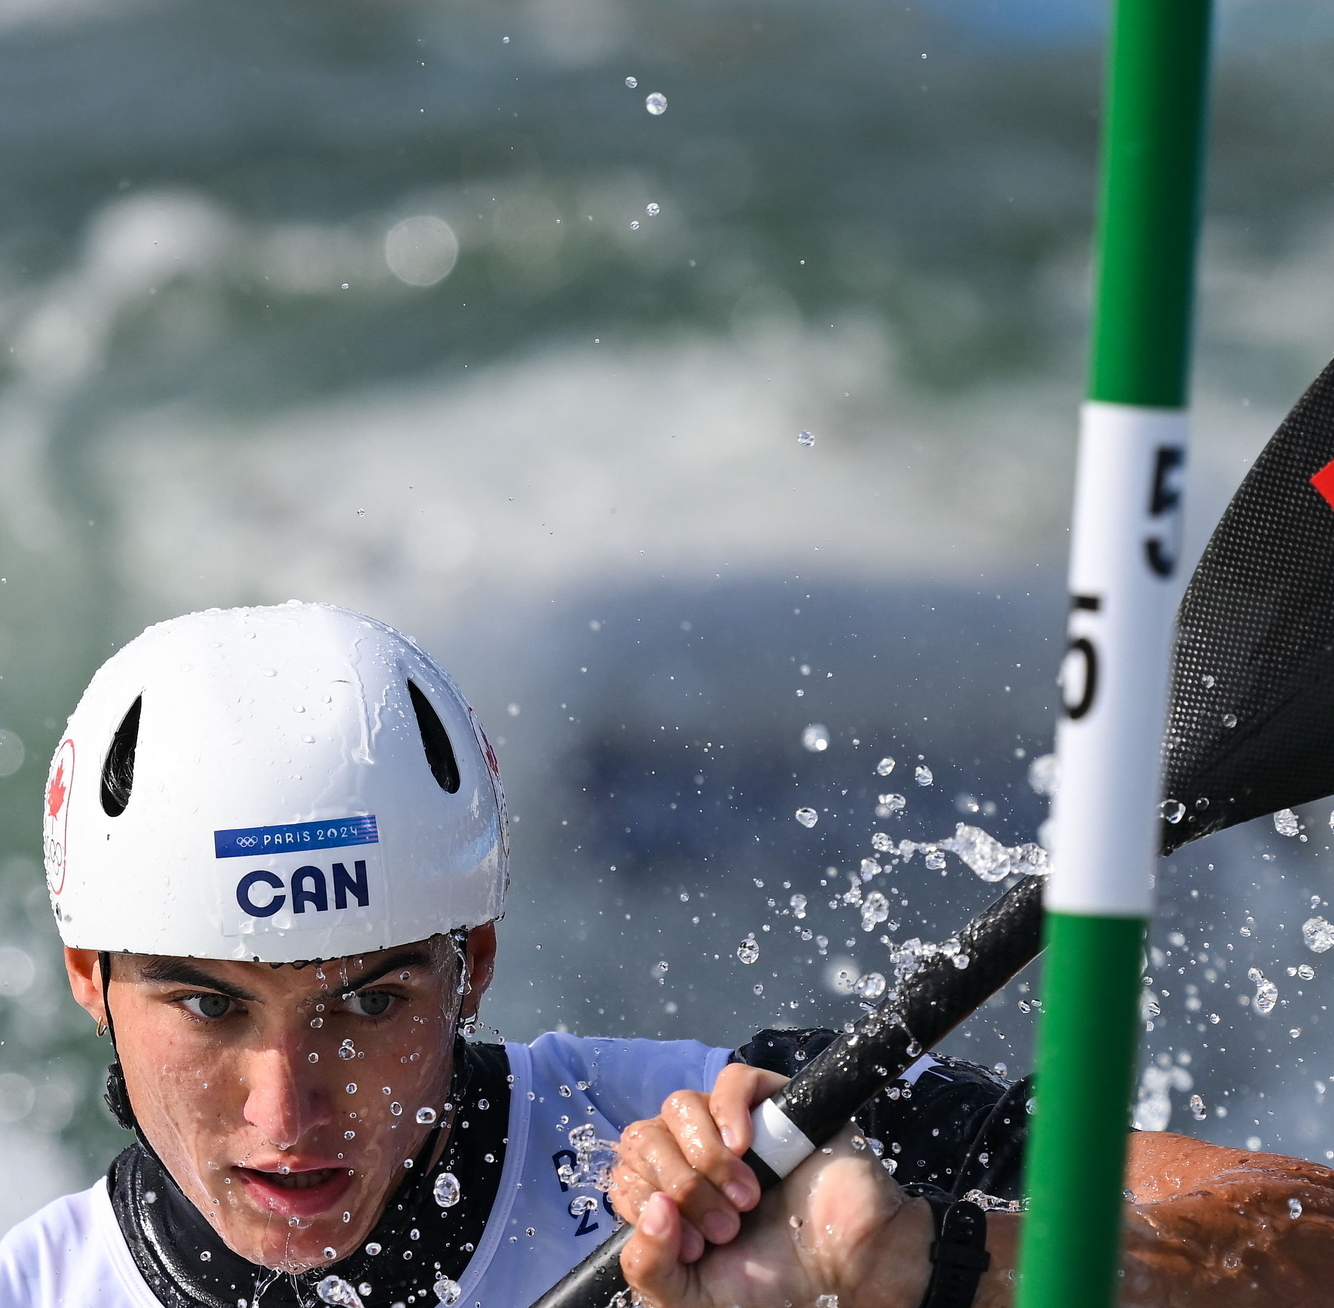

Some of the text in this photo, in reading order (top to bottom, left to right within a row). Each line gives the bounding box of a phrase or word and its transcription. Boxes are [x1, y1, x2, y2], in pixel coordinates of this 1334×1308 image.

[262, 826, 358, 847] PARIS 2024
[235, 859, 370, 918] CAN
